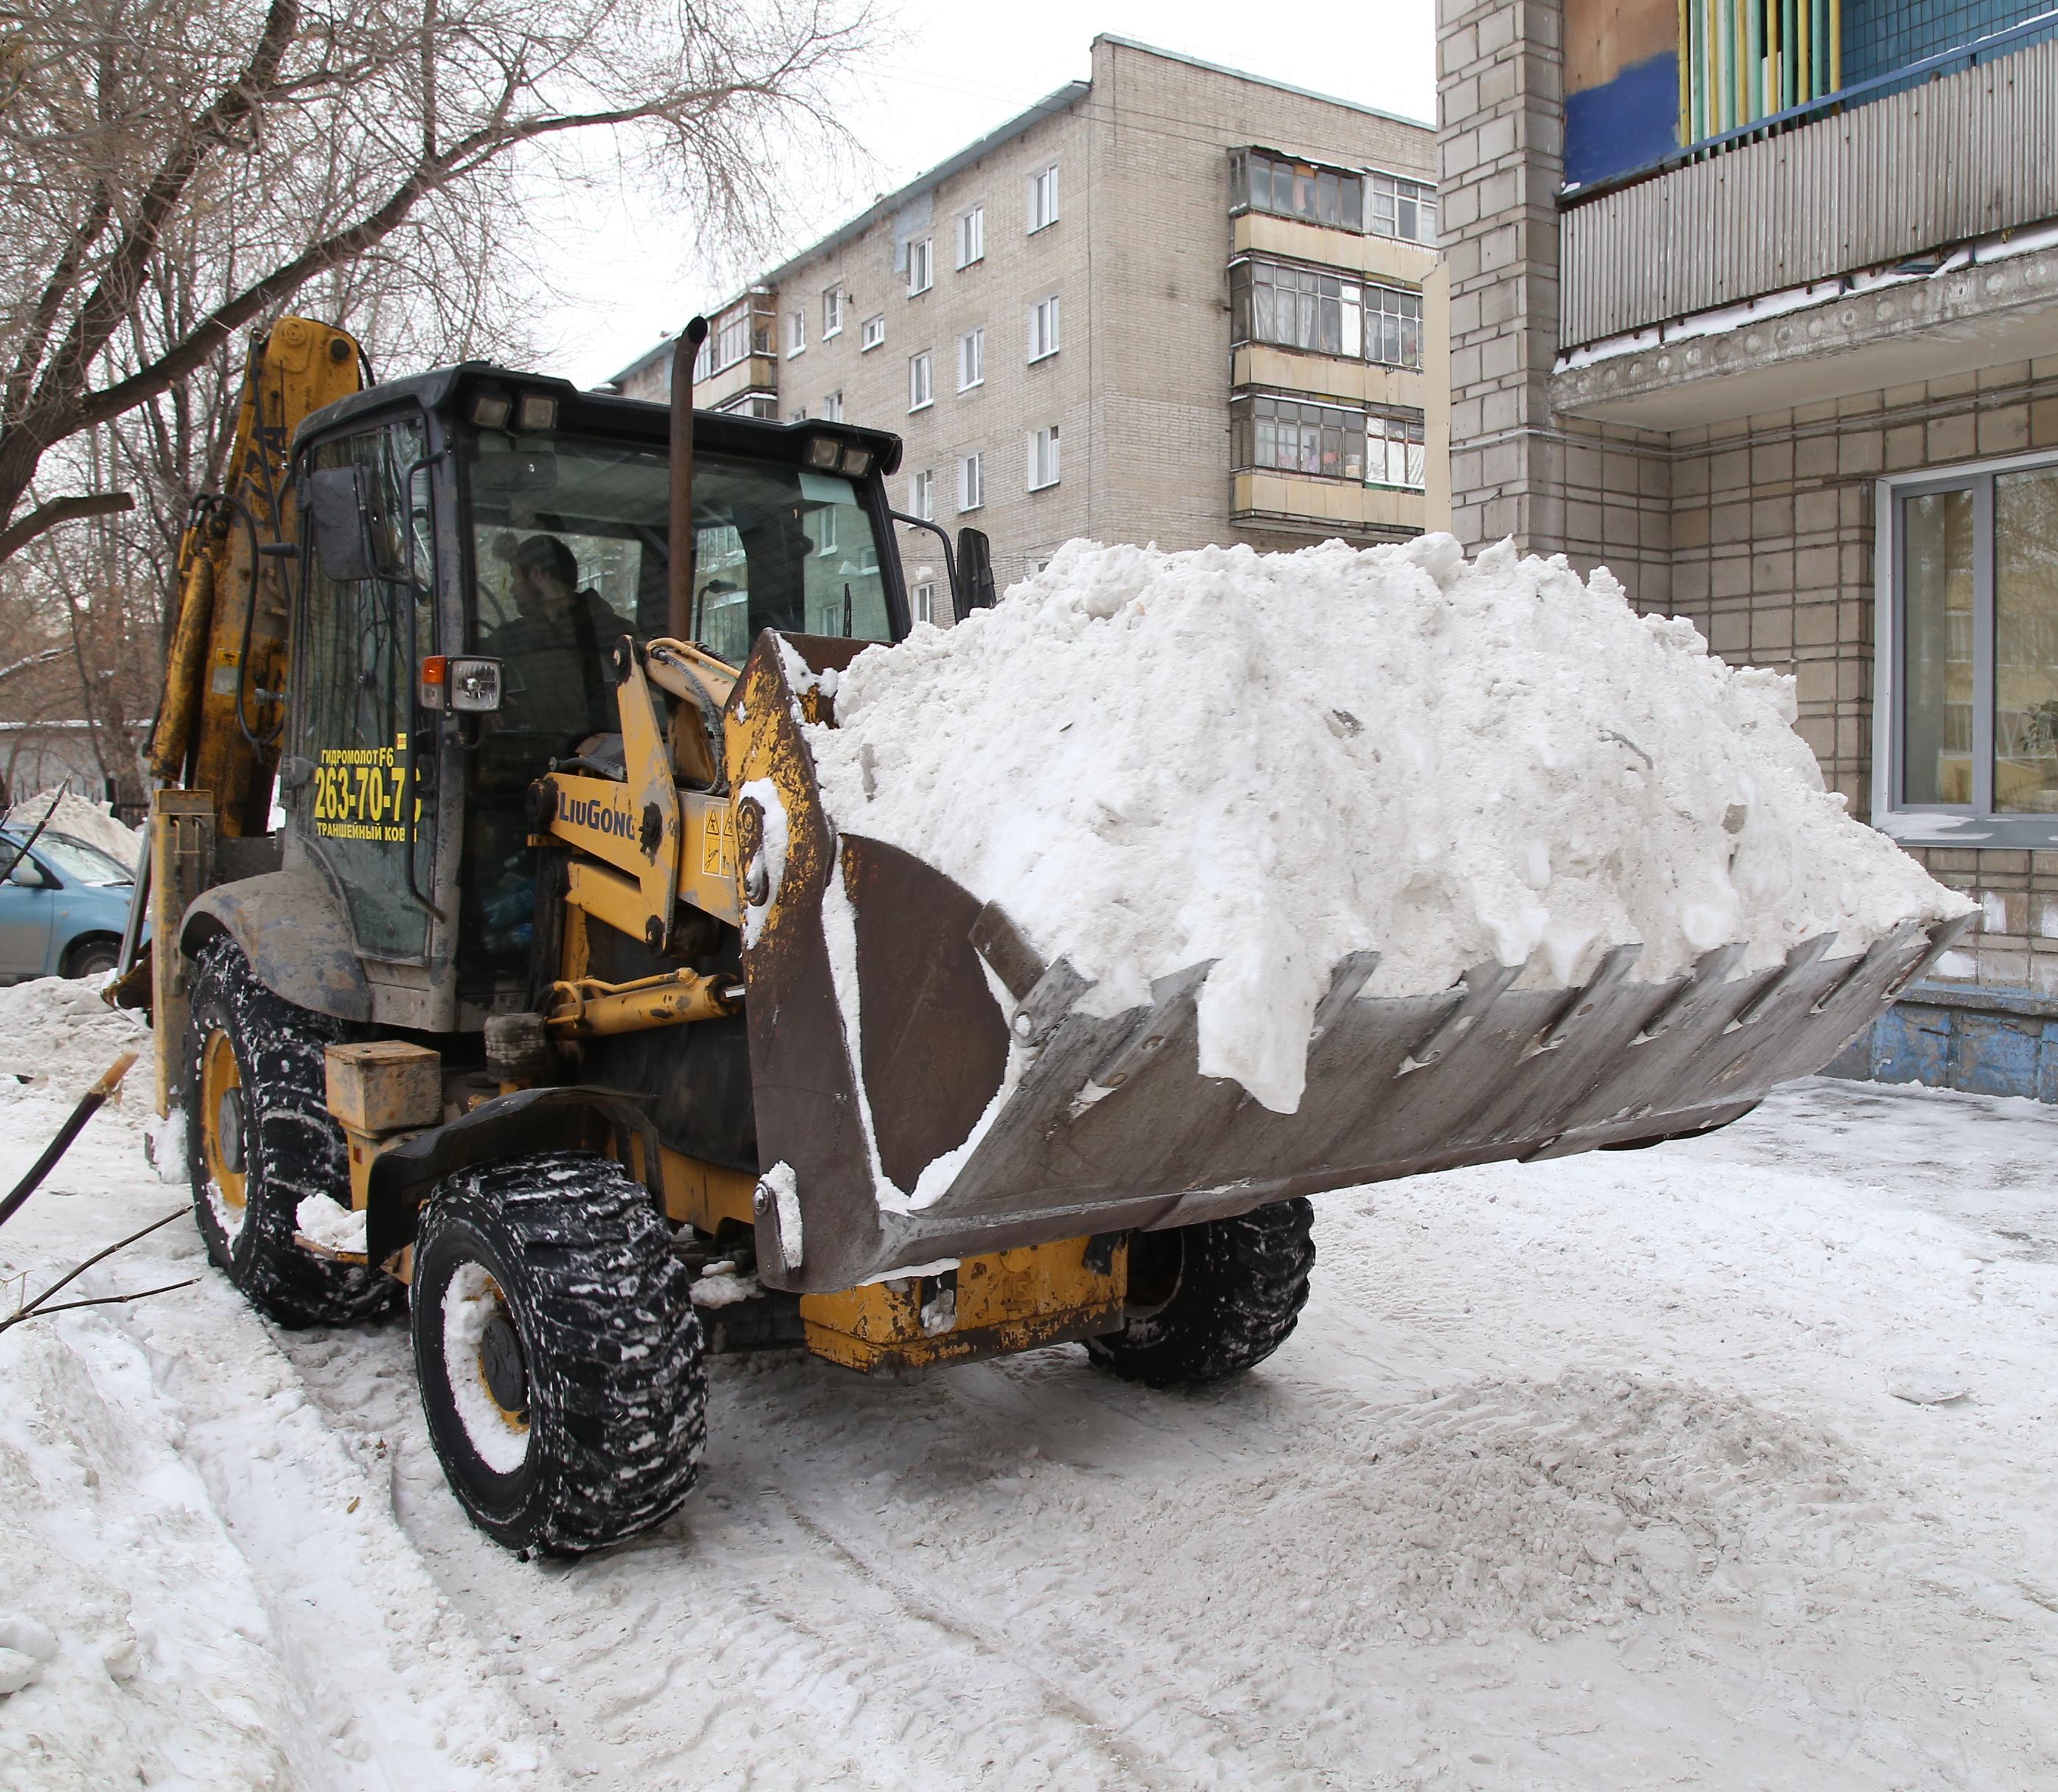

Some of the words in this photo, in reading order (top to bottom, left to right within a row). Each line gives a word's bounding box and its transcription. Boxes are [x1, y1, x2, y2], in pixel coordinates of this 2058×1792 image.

[321, 749, 378, 765] ГИДРОМОЛОТ
[379, 747, 394, 766] F6
[318, 822, 382, 840] ТРАНШЕЙНЫЙ
